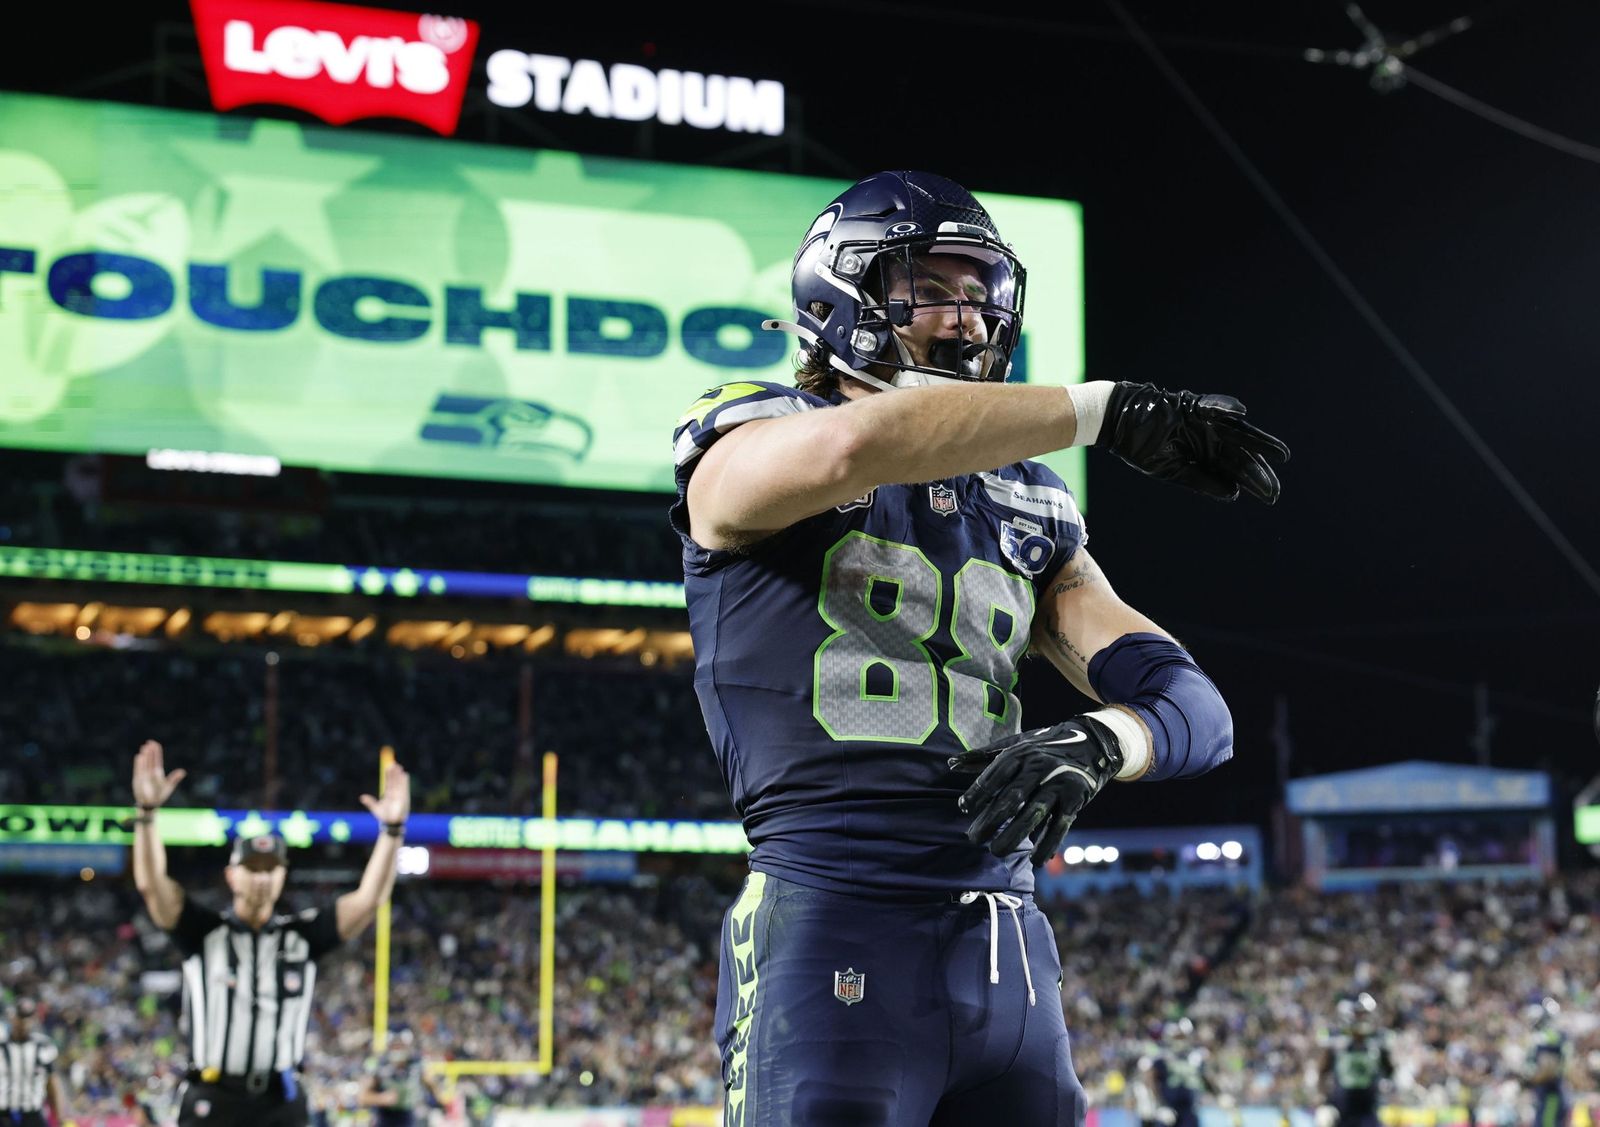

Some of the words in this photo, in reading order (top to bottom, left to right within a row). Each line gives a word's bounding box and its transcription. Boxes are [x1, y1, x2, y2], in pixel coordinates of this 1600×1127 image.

[486, 49, 784, 136] STADIUM
[934, 497, 953, 509] NFL
[1013, 491, 1064, 510] SEAHAWKS
[813, 530, 1035, 750] 88
[839, 983, 860, 998] NFL
